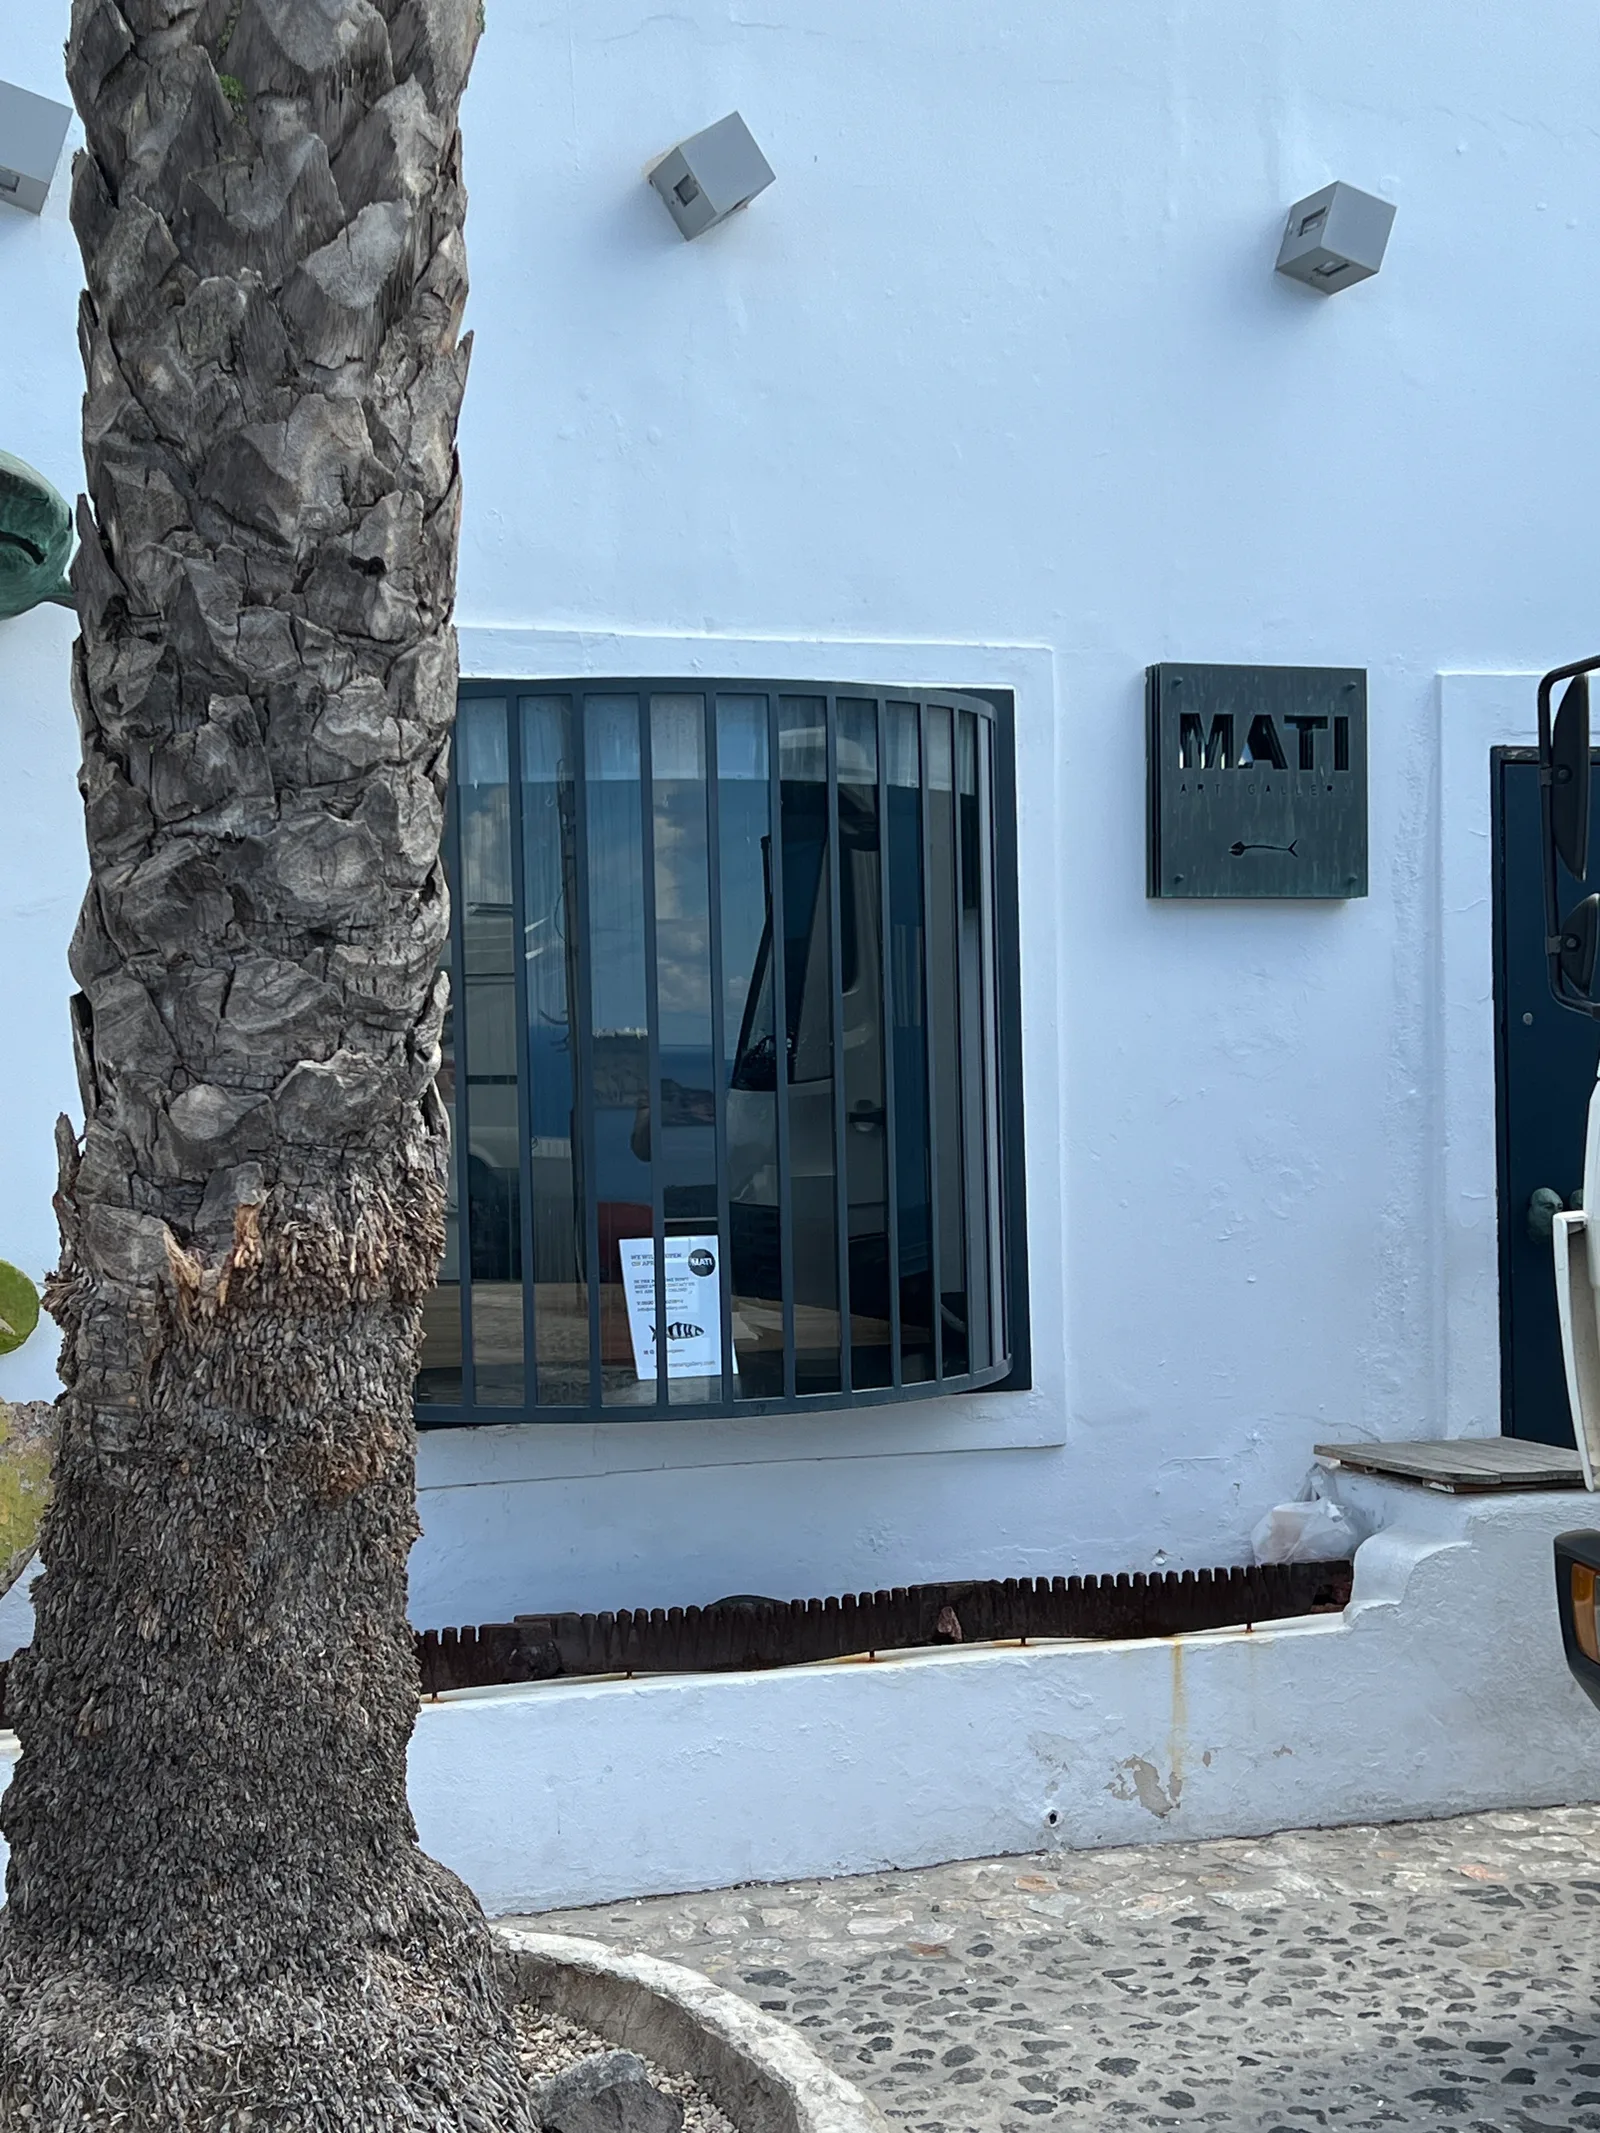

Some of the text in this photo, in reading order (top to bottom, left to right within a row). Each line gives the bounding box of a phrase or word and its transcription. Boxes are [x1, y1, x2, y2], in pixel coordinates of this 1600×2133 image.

[1179, 712, 1350, 770] MATI
[1180, 784, 1350, 796] ART GALLERY
[690, 1257, 713, 1266] MATI
